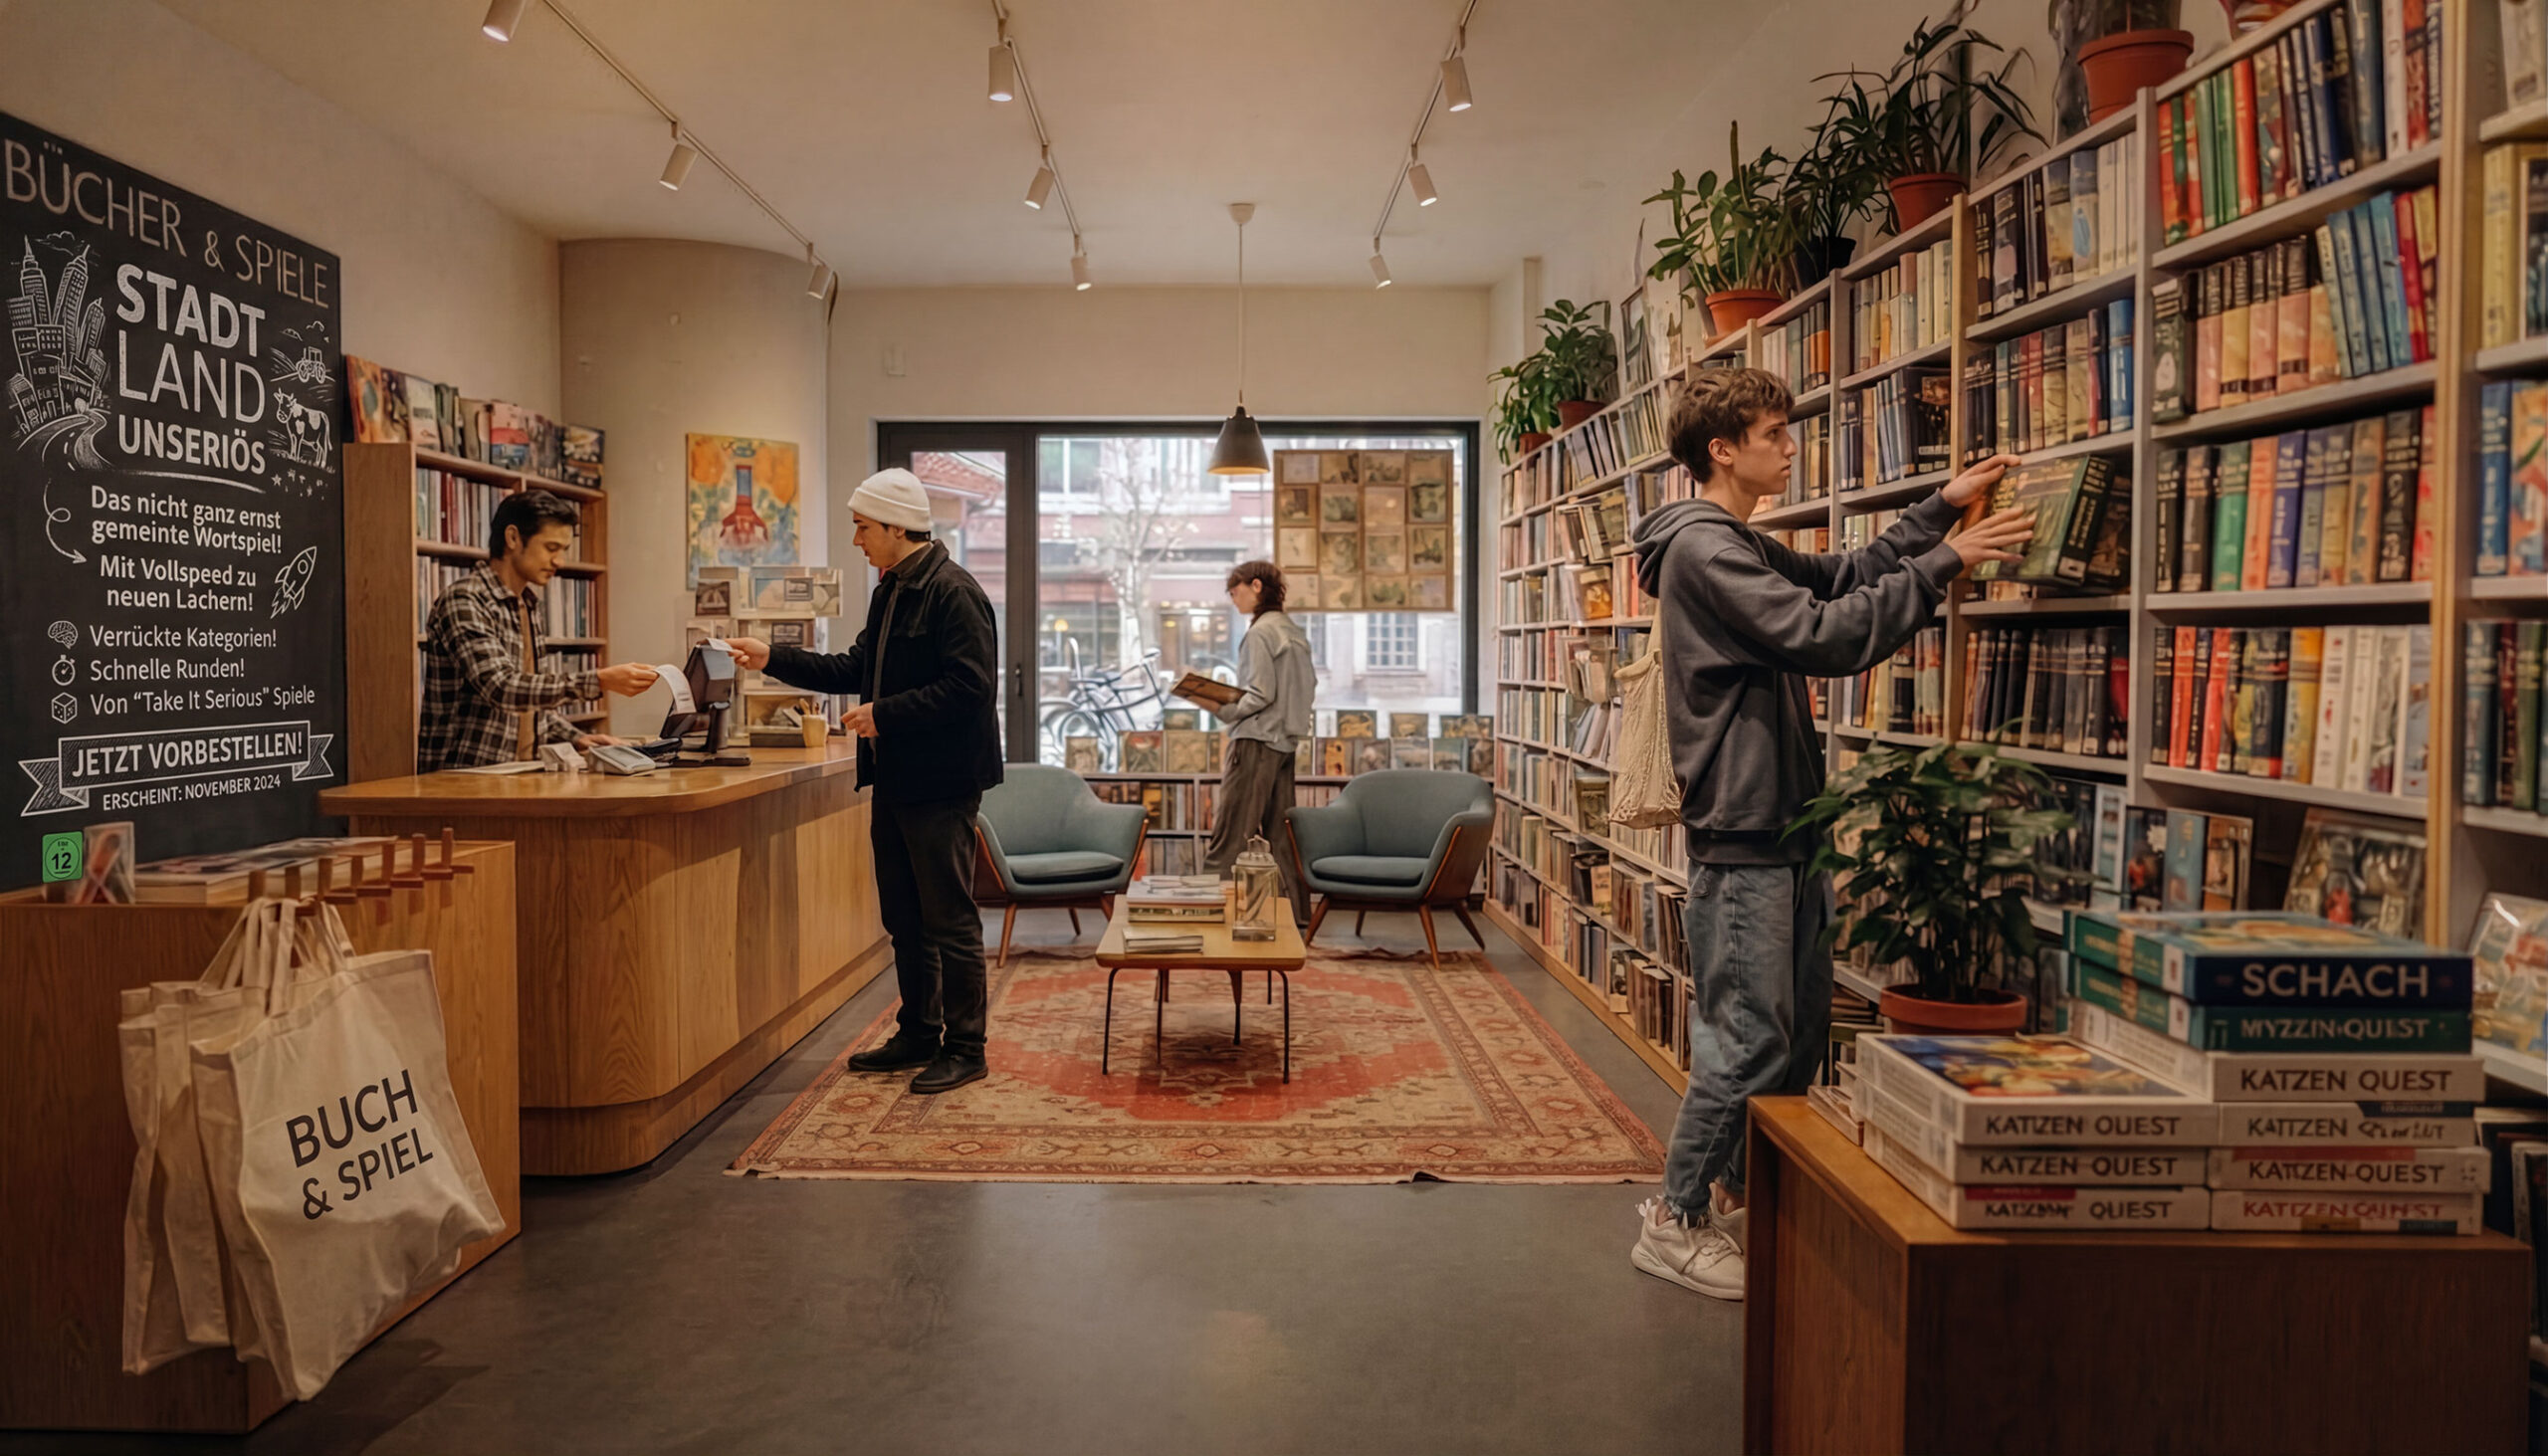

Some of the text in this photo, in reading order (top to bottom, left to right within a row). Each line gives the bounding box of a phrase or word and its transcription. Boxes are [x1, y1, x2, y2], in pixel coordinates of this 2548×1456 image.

[5, 139, 328, 309] BÜCHER & SPIELE
[117, 264, 265, 357] STADT
[119, 330, 265, 423] LAND
[119, 414, 265, 474] UNSERIÖS
[92, 486, 281, 528] Das nicht ganz ernst
[92, 518, 282, 556] gemeinte Wortspiel!
[101, 554, 256, 588] Mit Vollspeed zu
[106, 587, 253, 611] neuen Lachern!
[90, 625, 277, 651] Verrückte Kategorien!
[91, 658, 245, 681] Schnelle Runden!
[91, 695, 127, 716] Von
[189, 690, 201, 710] It
[274, 685, 315, 709] Spiele
[73, 731, 303, 777] JETZT VORBESTELLEN!
[103, 774, 281, 810] ERSCHEINT: NOVEMBER 2024
[51, 852, 72, 870] 12
[2242, 963, 2429, 996] SCHACH
[2240, 1070, 2451, 1093] KATZEN QUEST
[286, 1069, 418, 1167] BUCH
[303, 1128, 433, 1220] & SPIEL
